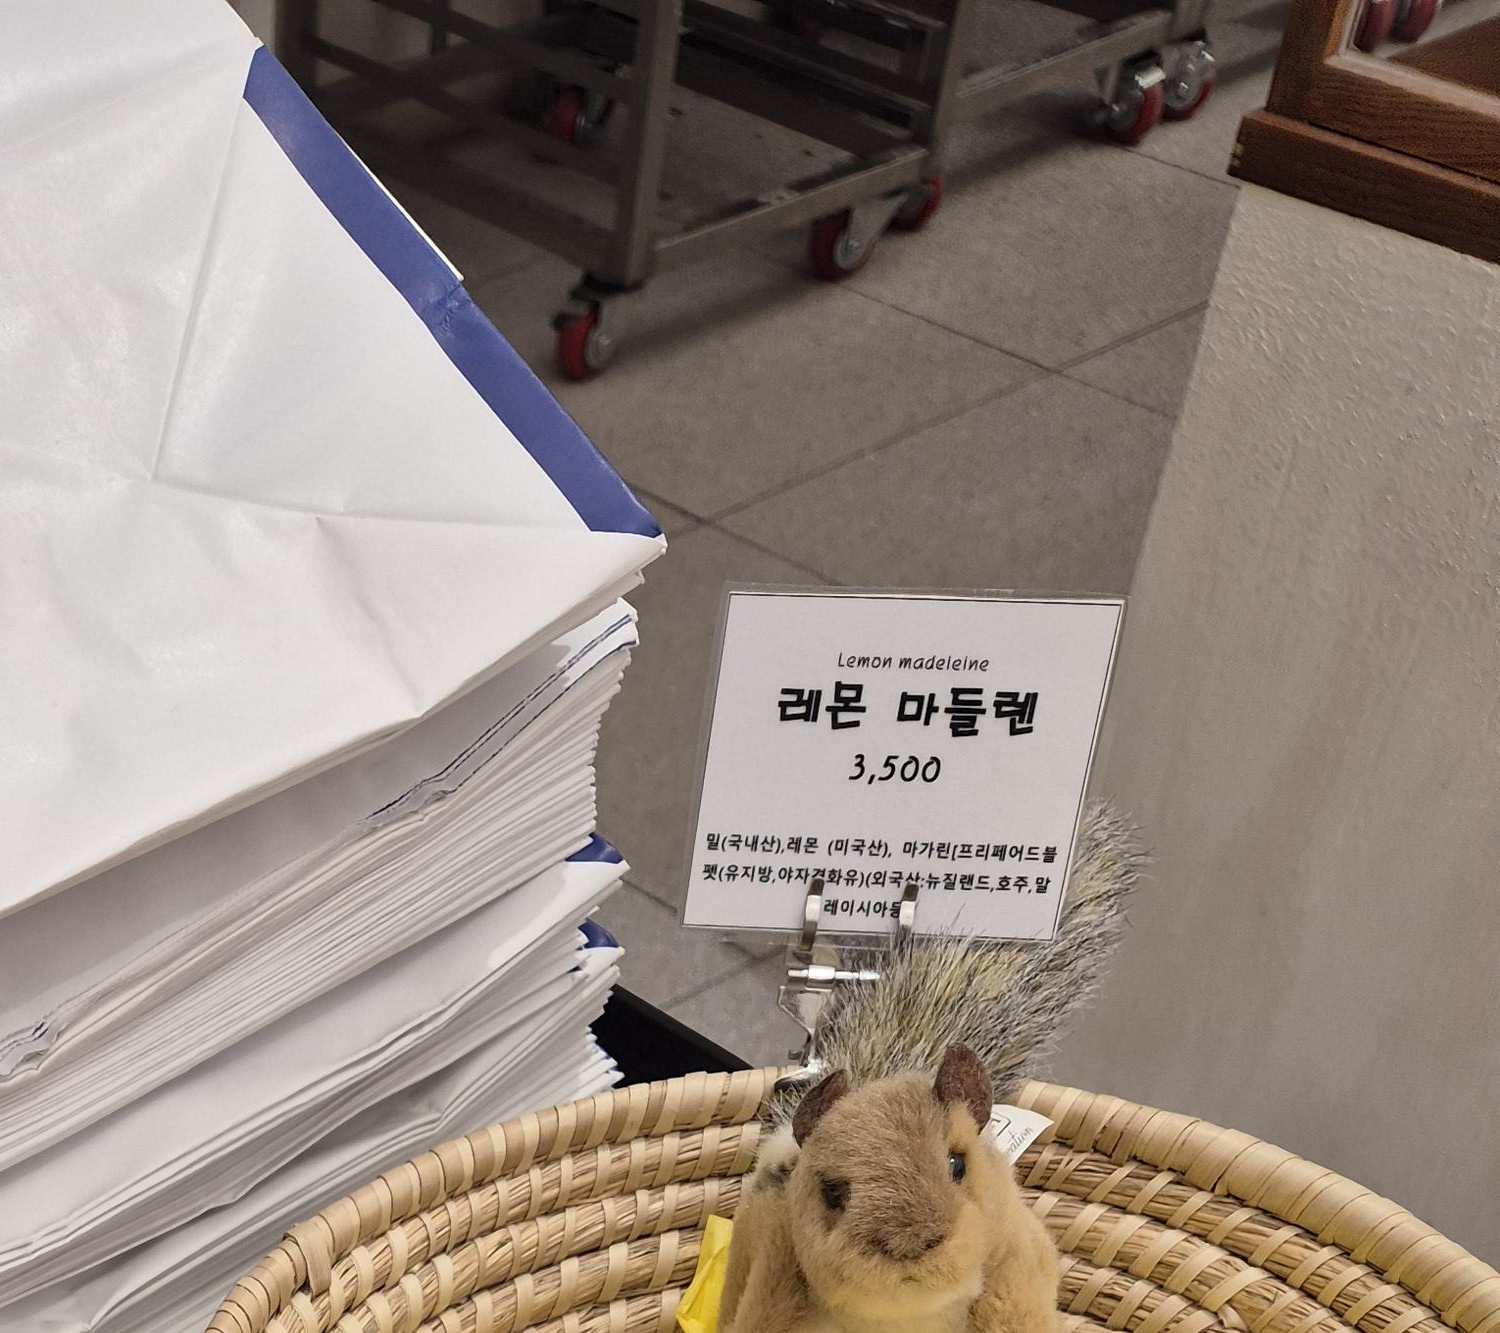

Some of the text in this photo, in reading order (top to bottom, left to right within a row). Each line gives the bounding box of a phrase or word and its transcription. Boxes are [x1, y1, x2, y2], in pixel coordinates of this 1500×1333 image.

[838, 652, 990, 672] Lemon madeleine
[777, 681, 1039, 737] 레몬 마들렌
[848, 753, 942, 785] 3,500
[706, 832, 1058, 864] 밀(국내산),레몬 (미국산), 마가린[프리페어드블
